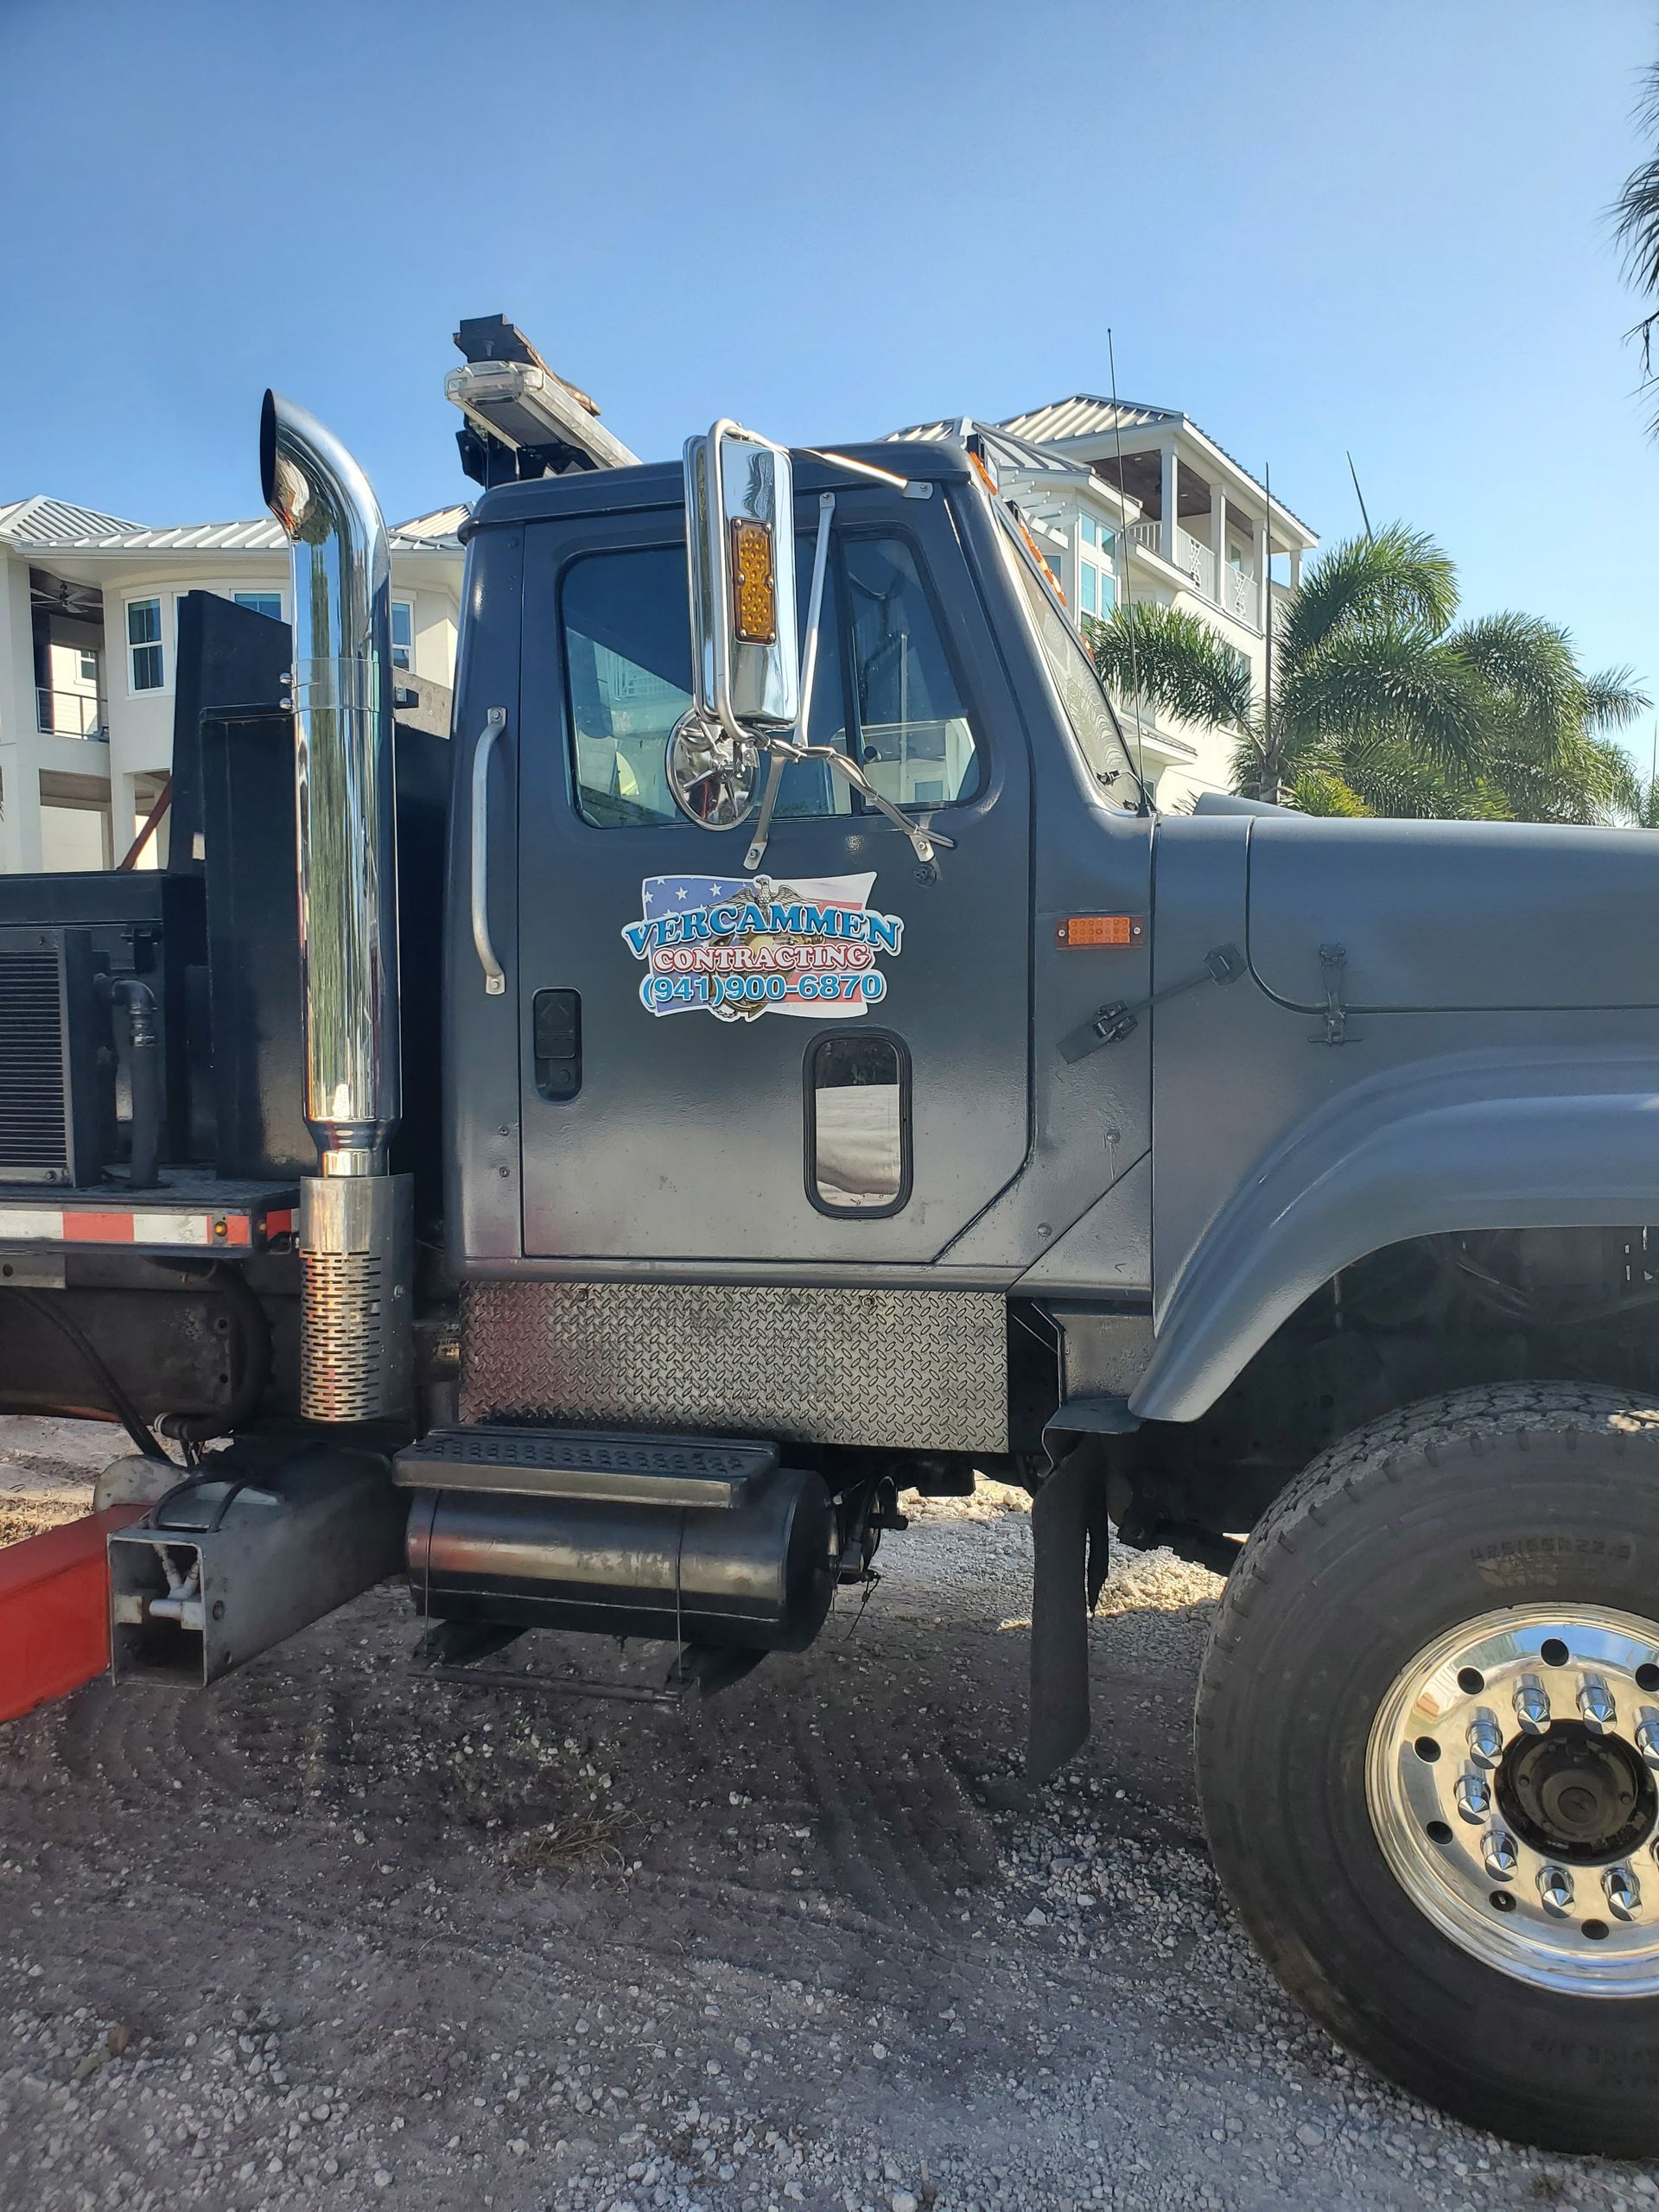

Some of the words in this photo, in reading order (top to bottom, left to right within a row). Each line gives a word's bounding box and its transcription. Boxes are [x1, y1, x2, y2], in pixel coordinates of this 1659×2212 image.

[624, 904, 901, 955] VERCAMMEN
[652, 944, 873, 973] CONTRACTING
[641, 973, 885, 1008] (941)900-6870
